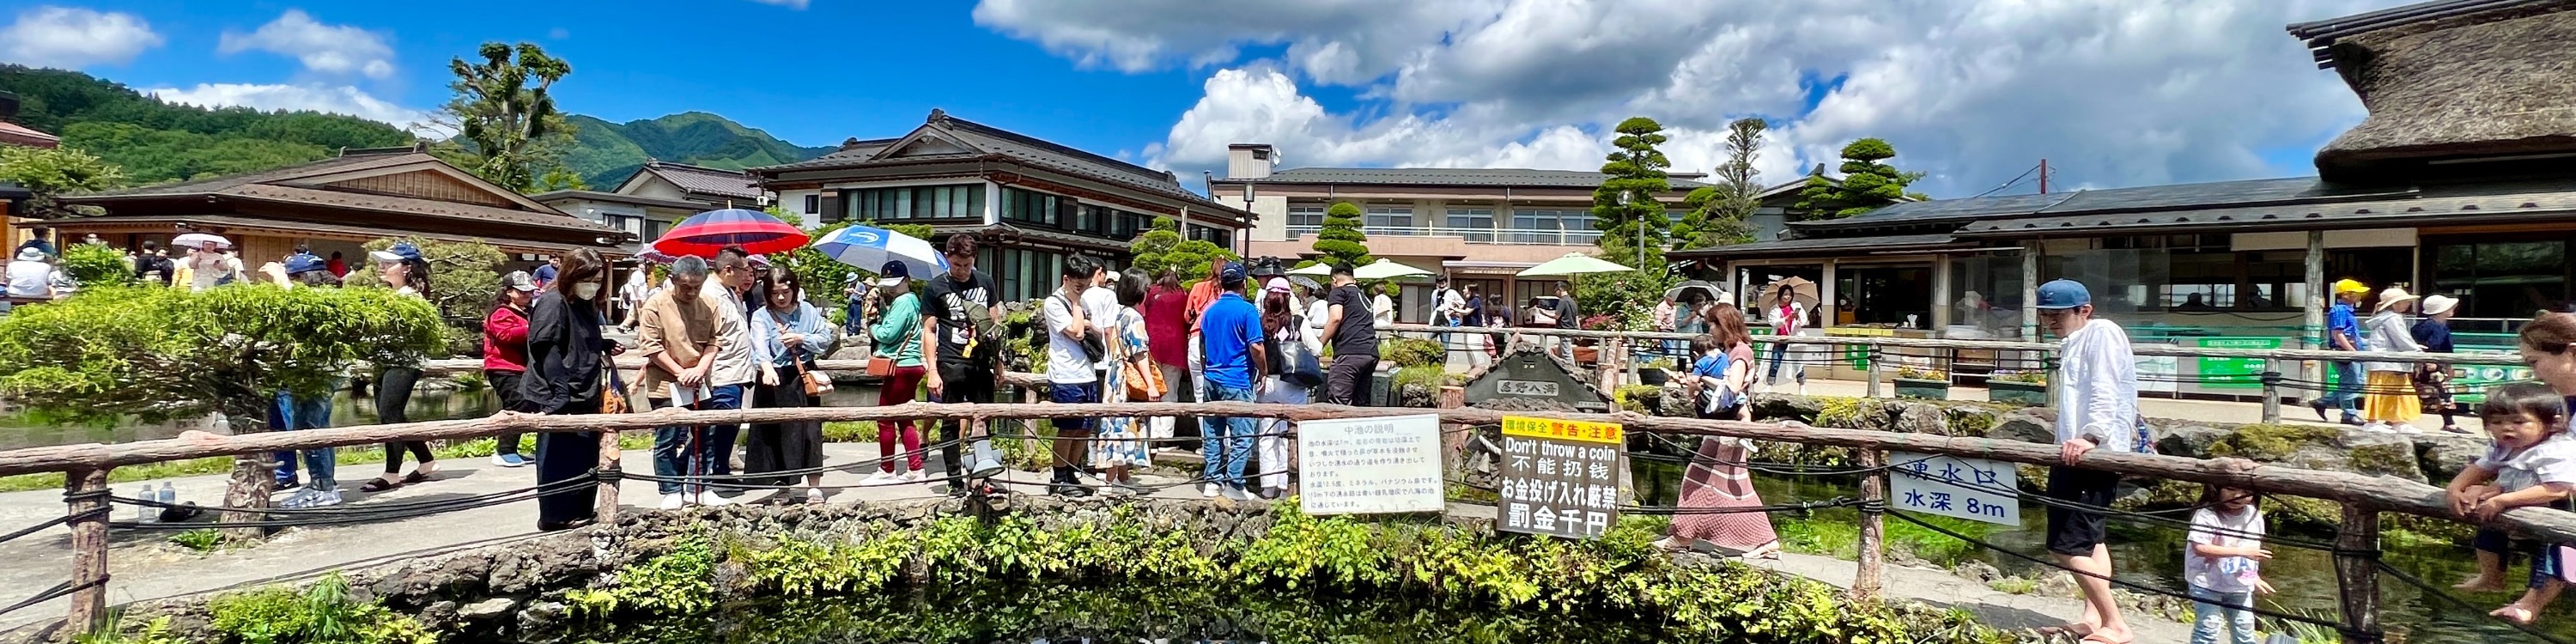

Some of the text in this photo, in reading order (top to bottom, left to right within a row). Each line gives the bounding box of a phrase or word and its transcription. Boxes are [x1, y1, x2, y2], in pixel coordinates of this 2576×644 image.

[1344, 423, 1394, 435] 中池の説明
[1505, 419, 1547, 434] 環境保全
[1505, 437, 1616, 462] Don't throw a coin
[1511, 454, 1609, 480] 不能扔钱
[1501, 476, 1617, 510] お金投げ入れ厳禁
[1905, 489, 2005, 518] 水深 8m
[1508, 501, 1608, 536] 罰金千円
